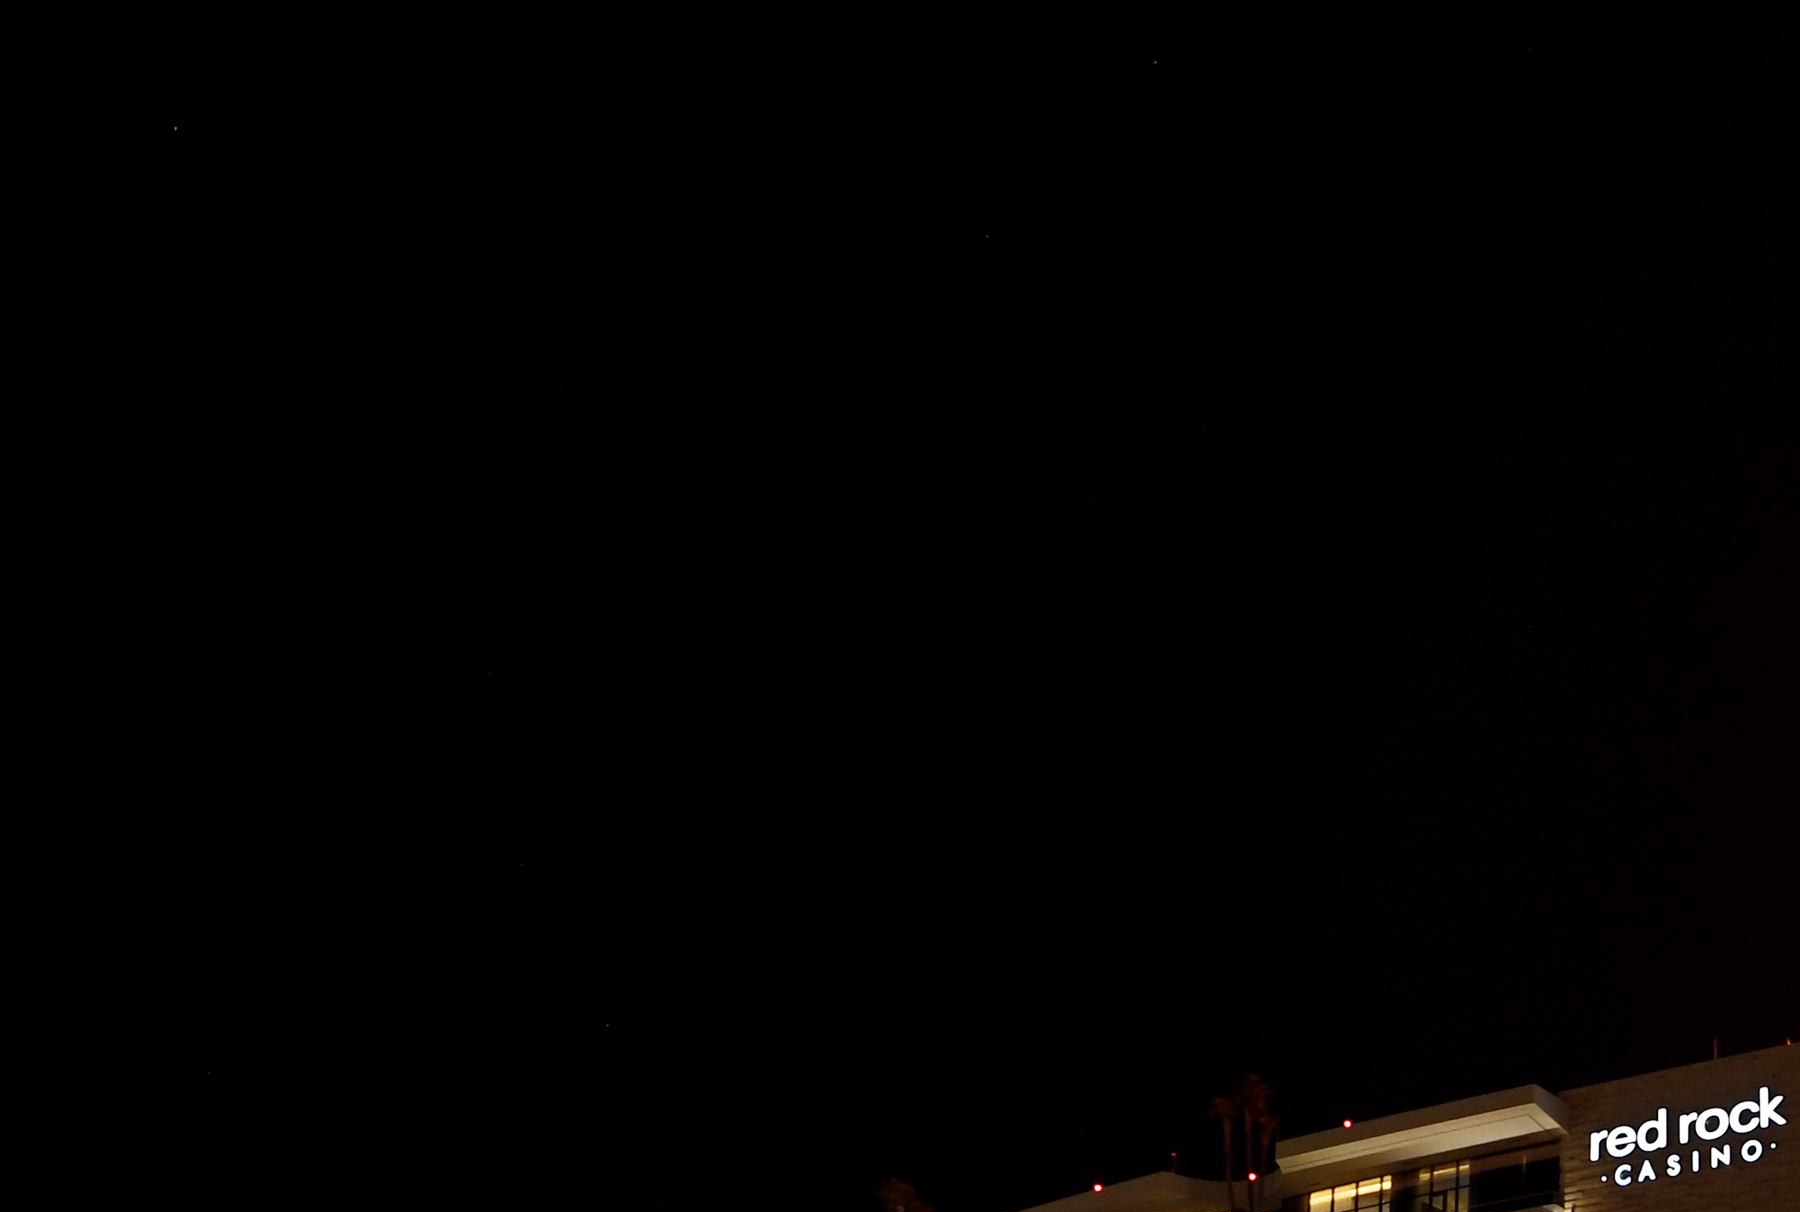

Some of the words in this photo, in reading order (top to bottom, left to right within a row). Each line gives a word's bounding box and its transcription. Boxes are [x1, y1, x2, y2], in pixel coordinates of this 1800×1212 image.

[1589, 1107, 1667, 1162] red
[1679, 1086, 1787, 1145] rock
[1614, 1139, 1763, 1187] CASINO
